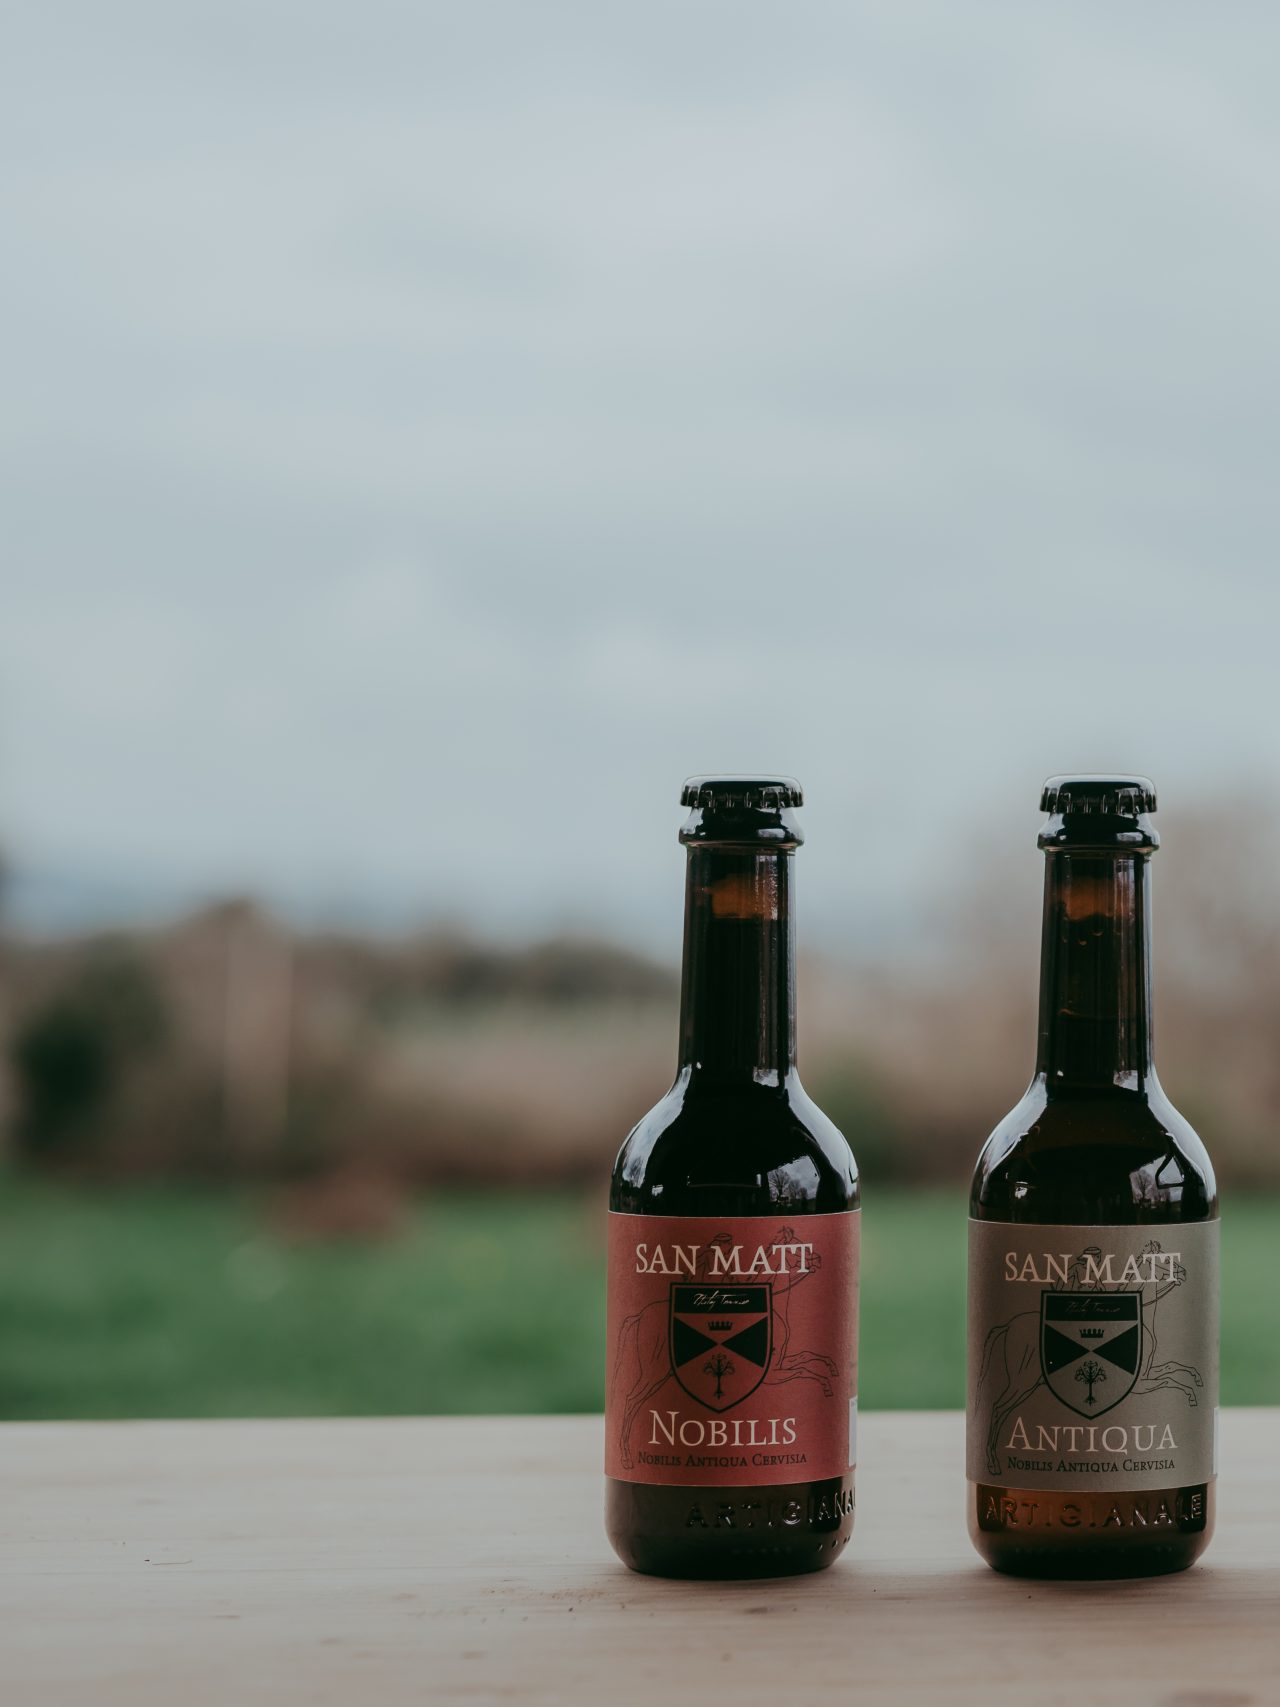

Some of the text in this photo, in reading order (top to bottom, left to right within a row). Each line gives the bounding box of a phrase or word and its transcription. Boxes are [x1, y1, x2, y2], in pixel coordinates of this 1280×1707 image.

[635, 1243, 814, 1276] SAN MATT
[1005, 1251, 1182, 1285] SAN MATT
[648, 1409, 798, 1448] NOBILIS
[1005, 1416, 1179, 1456] ANTIQUA
[637, 1451, 808, 1468] NOBILIS ANTIQUA CERVISIA
[1007, 1456, 1176, 1474] NOBILIS ANTIQUA CERVISIA
